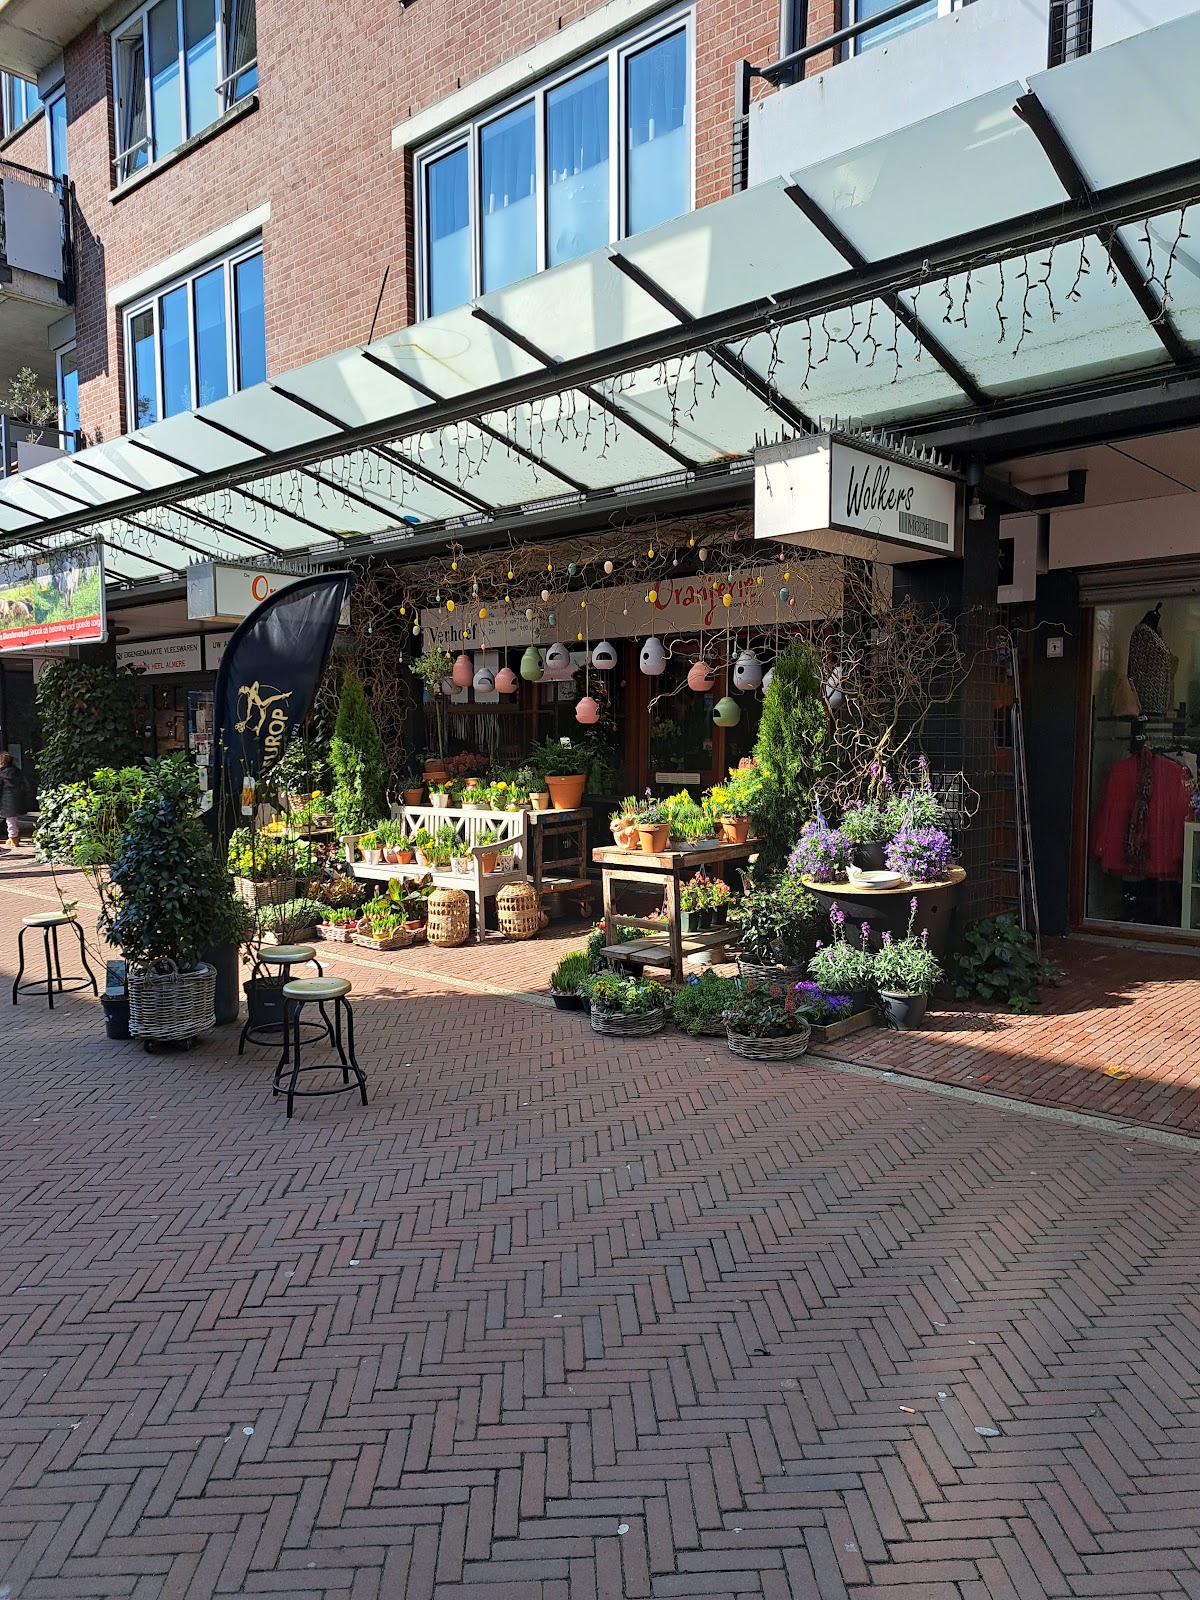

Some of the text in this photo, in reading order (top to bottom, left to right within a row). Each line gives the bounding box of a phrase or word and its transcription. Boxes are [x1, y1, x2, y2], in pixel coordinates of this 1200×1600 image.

[846, 464, 914, 518] Wolkers
[652, 570, 757, 626] Oranjerie
[76, 620, 90, 630] goede
[91, 619, 101, 627] zorg
[428, 623, 478, 643] Verhoef
[123, 647, 163, 659] EIGENGEMAAKTE
[164, 644, 198, 654] VLEESWAREN
[212, 641, 221, 649] UW
[151, 662, 165, 670] HEEL
[165, 660, 186, 669] ALMERE
